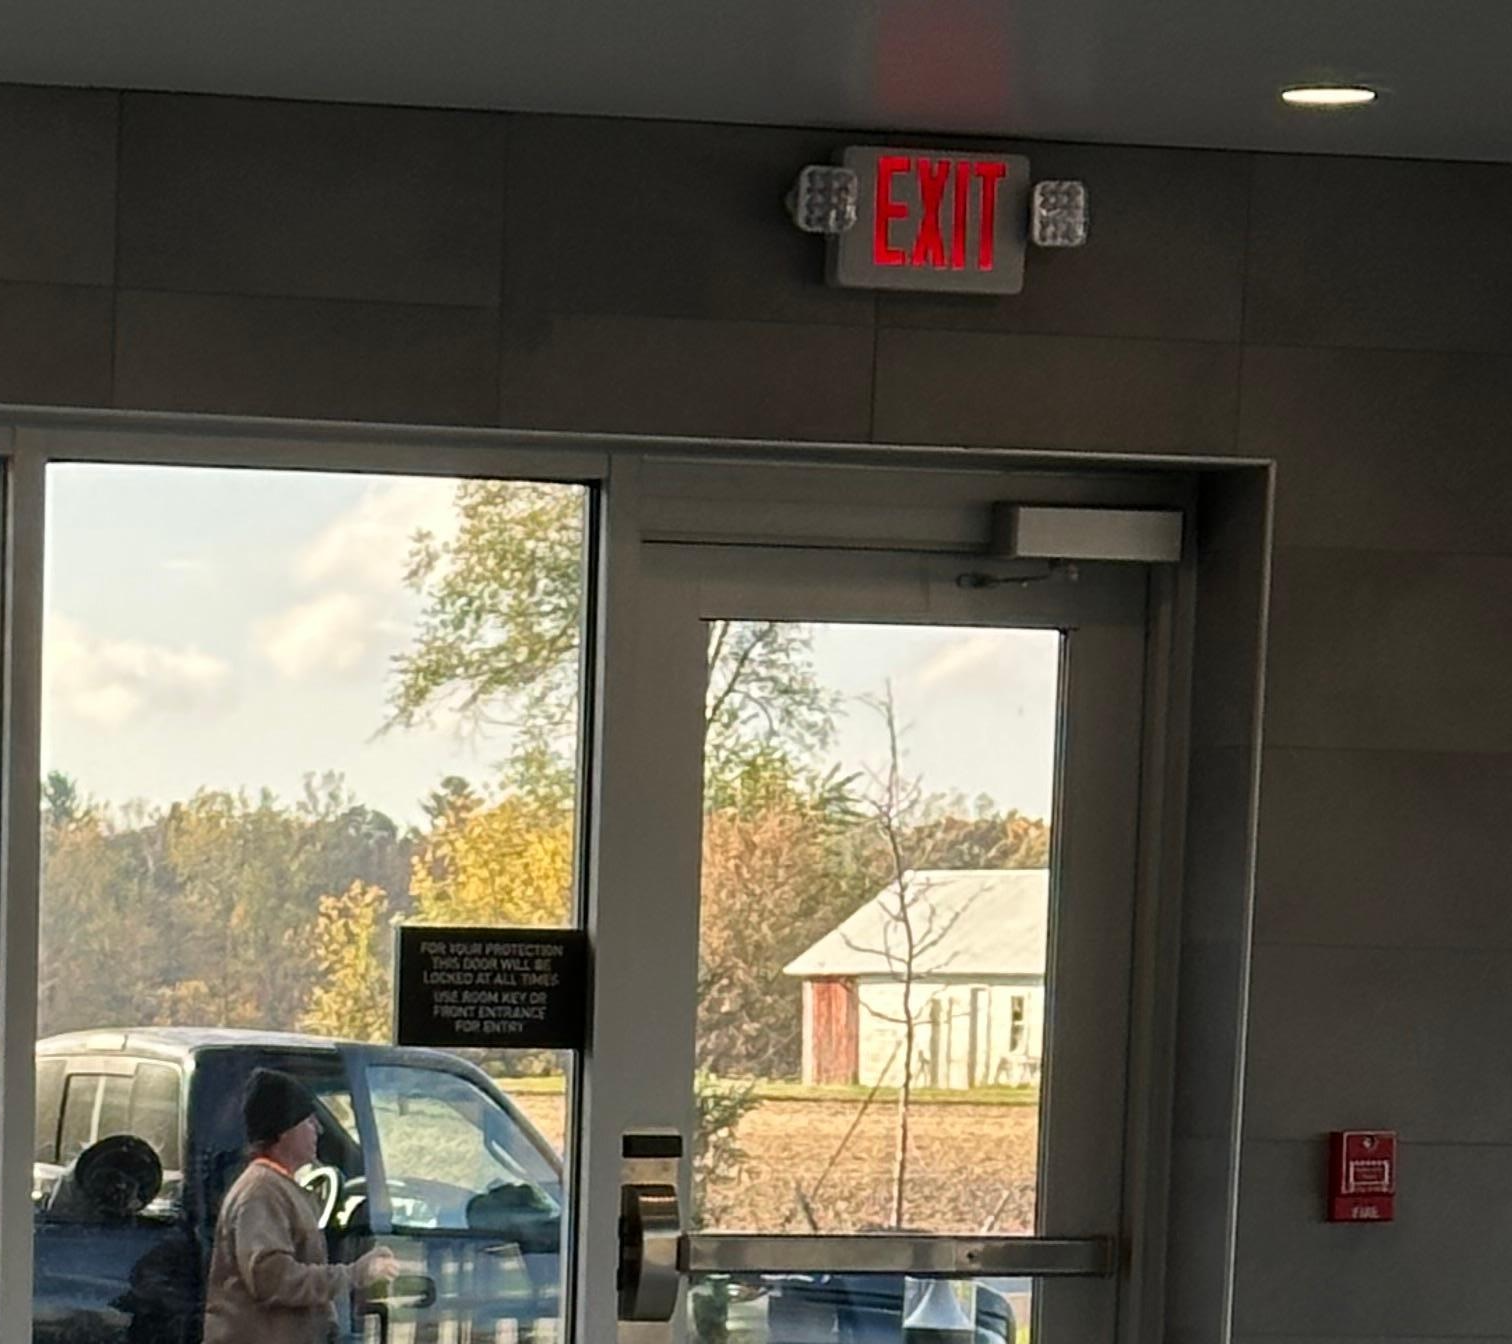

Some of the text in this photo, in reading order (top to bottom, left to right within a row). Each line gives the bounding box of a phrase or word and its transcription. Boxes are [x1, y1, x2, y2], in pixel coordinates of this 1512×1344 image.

[873, 156, 1007, 271] EXIT
[420, 942, 564, 957] FOR YOUR PROTECTION
[432, 957, 552, 972] THIS DOOR WILL BE
[423, 971, 560, 987] LOCKED AT ALL TIMES
[434, 990, 548, 1005] USE ROOM KEY OR
[433, 1005, 547, 1020] FRONT ENTRANCE
[455, 1020, 524, 1034] FOR ENTRY
